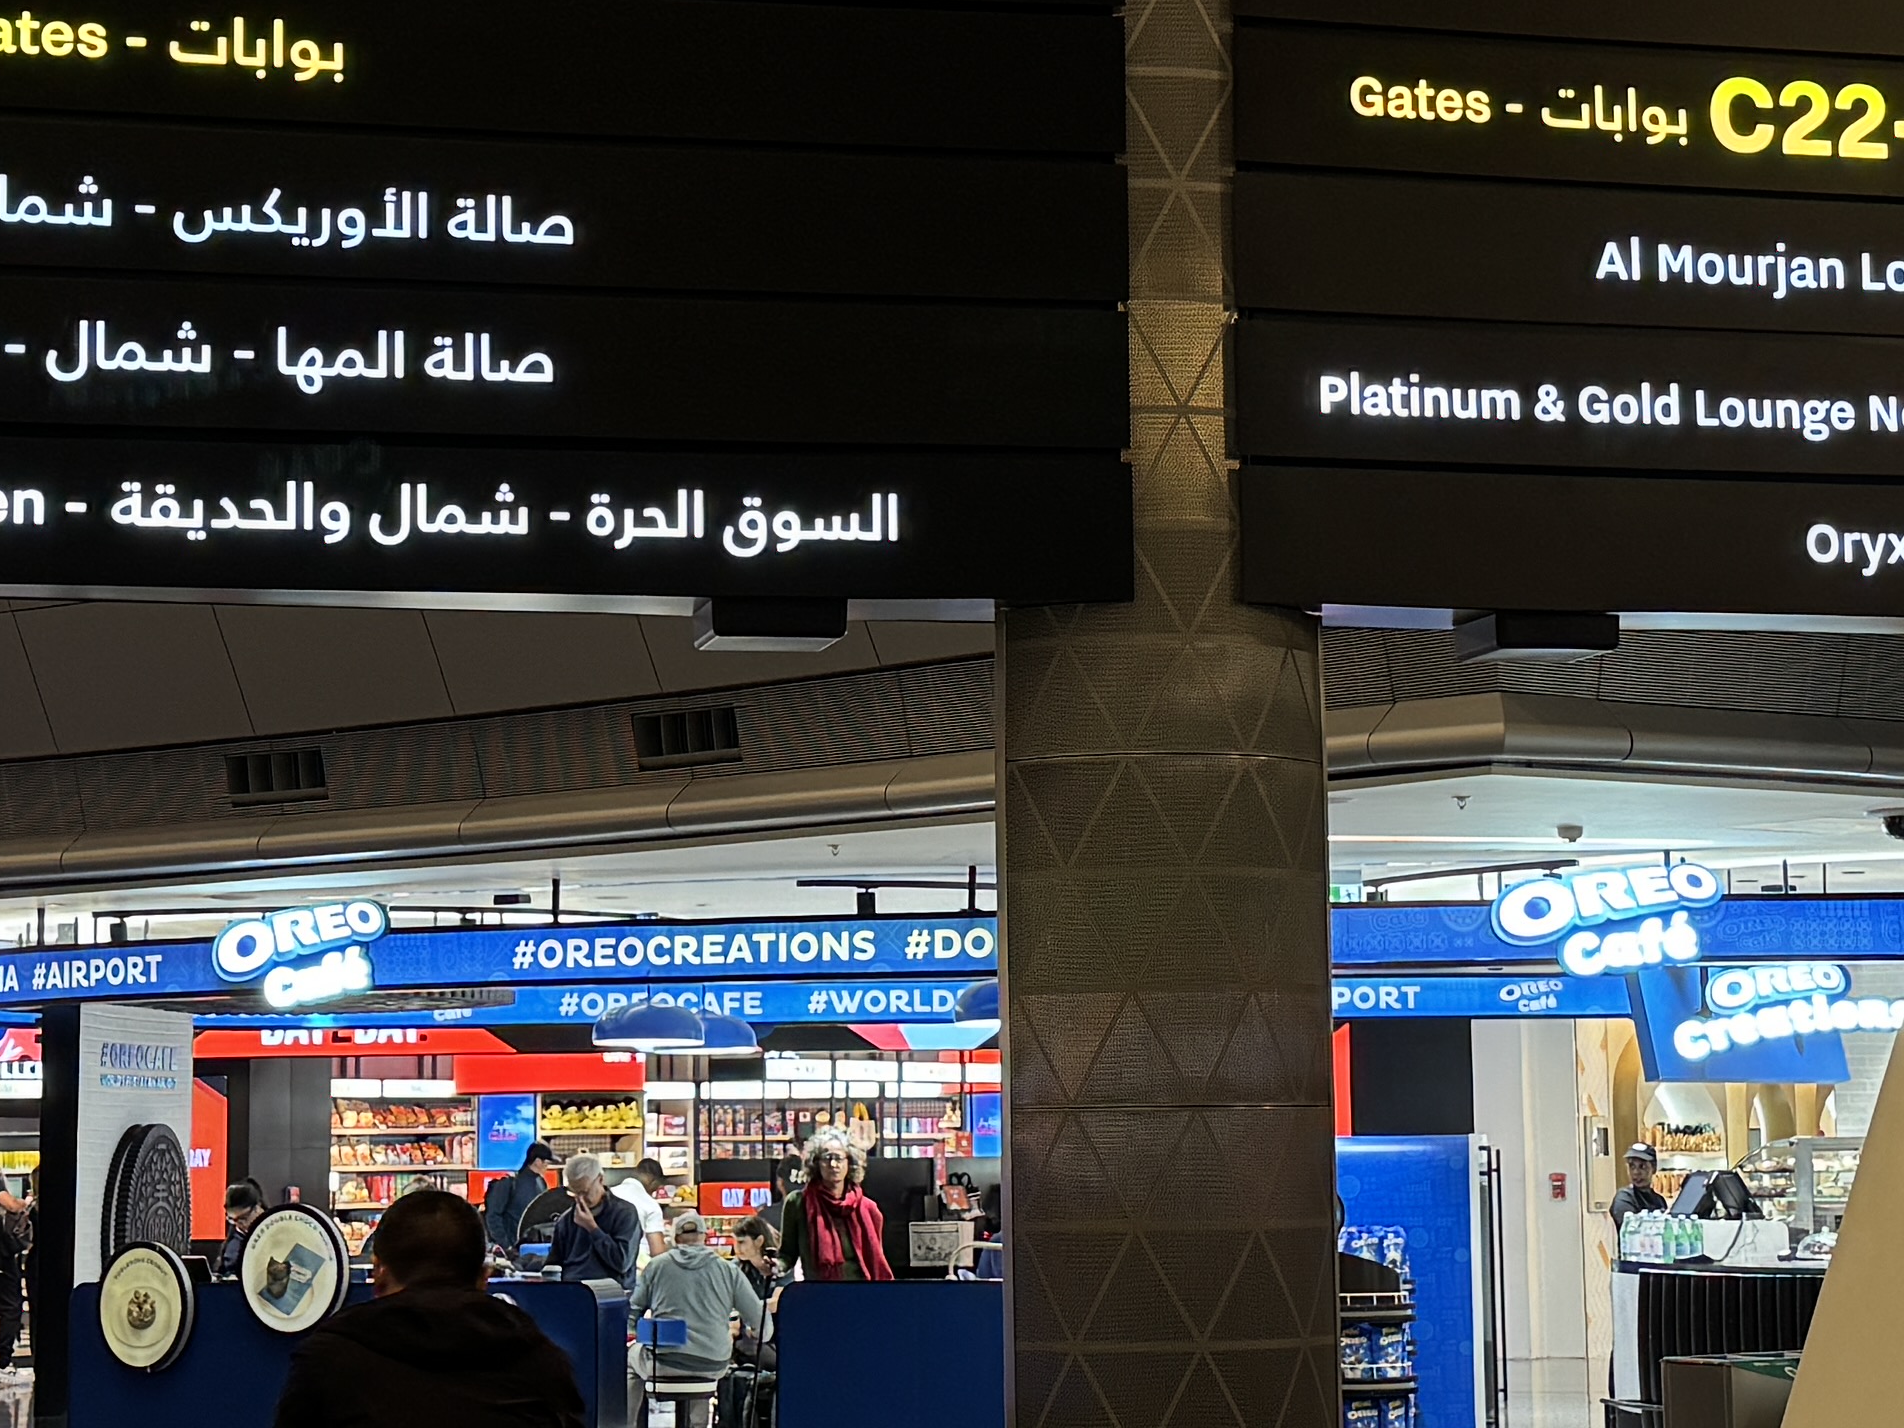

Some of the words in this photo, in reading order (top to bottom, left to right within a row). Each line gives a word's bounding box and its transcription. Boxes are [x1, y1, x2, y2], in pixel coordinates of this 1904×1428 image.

[167, 15, 346, 85] بوابات
[1348, 74, 1493, 125] Gates
[1540, 83, 1689, 148] بوابات
[171, 186, 429, 250] الأوريكس
[445, 193, 575, 246] صالة
[1594, 234, 1642, 283] Al
[1656, 241, 1846, 301] Mourjan
[44, 318, 213, 383] شمال
[275, 325, 406, 396] المها
[422, 331, 555, 384] صالة
[1318, 369, 1522, 422] Platinum
[1532, 382, 1567, 424] &
[1576, 380, 1682, 427] Gold
[1694, 388, 1857, 443] Lounge
[109, 479, 352, 546] والحديقة
[367, 481, 530, 547] شمال
[585, 487, 706, 551] الحرة
[721, 491, 900, 559] السوق
[1498, 865, 1717, 938] OREO
[215, 901, 387, 974] OREO
[512, 929, 876, 970] #OREOCREATIONS
[1562, 910, 1699, 976] Café
[32, 954, 163, 991] #AIRPORT
[807, 988, 963, 1015] #WORLD
[1499, 980, 1563, 1002] OREO
[1711, 965, 1842, 1009] OREO
